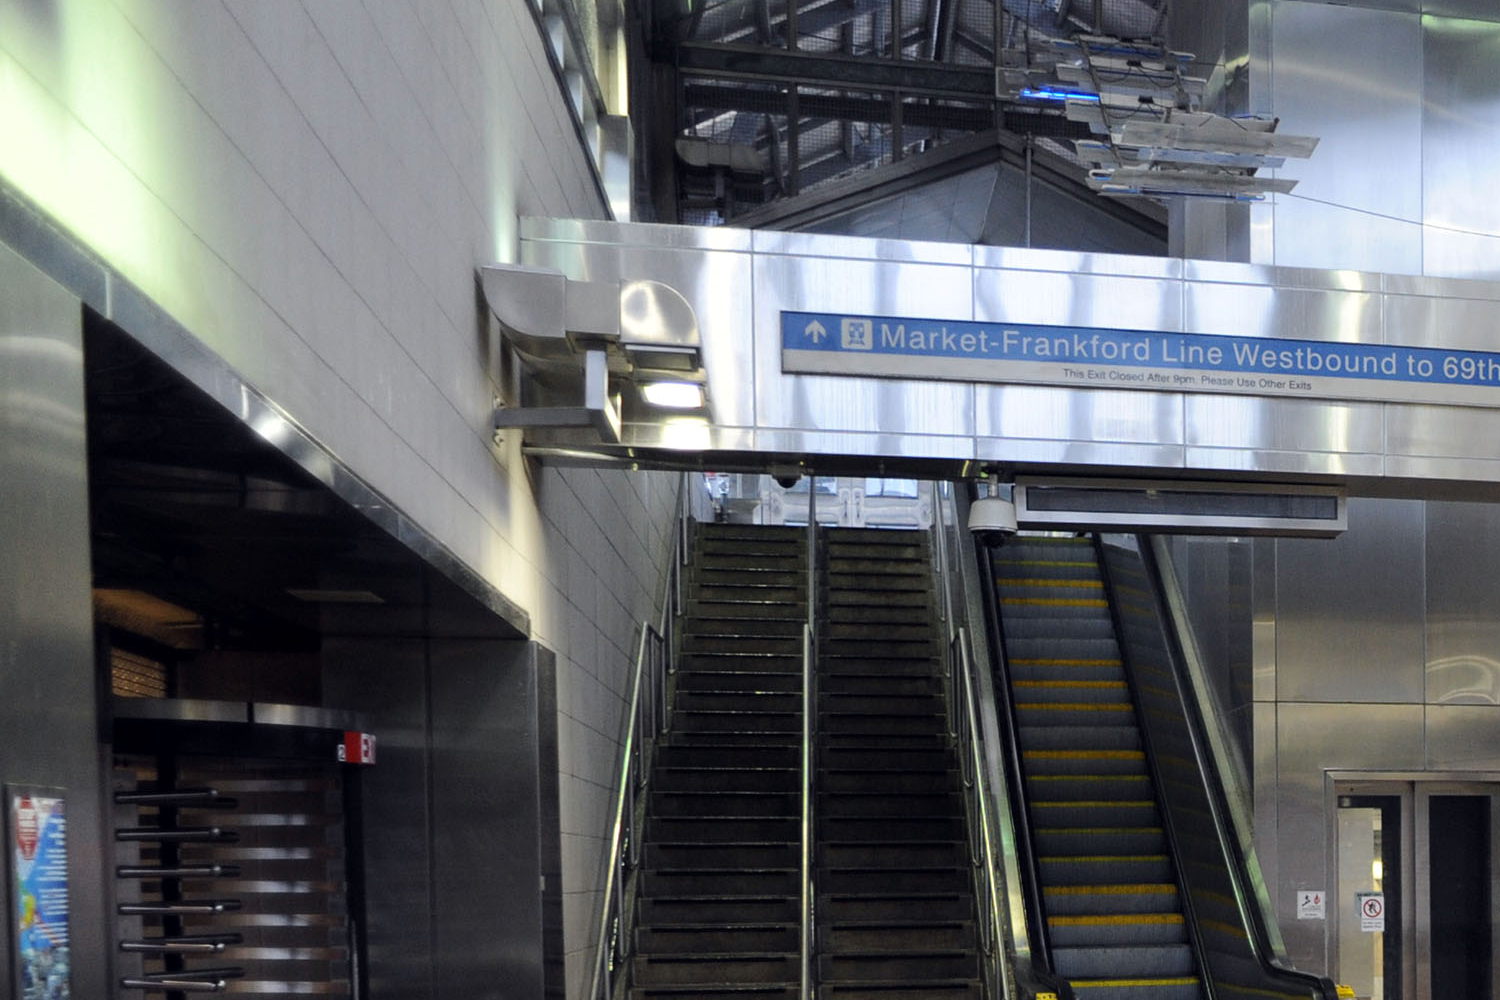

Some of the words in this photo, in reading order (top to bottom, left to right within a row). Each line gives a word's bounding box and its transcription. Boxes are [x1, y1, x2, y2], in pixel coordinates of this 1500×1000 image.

[881, 324, 1151, 361] Market-Frankford
[1162, 339, 1224, 364] Line
[1233, 342, 1398, 376] Westbound
[1407, 355, 1433, 377] to
[1063, 368, 1085, 379] This
[1087, 370, 1106, 380] Exit
[1109, 371, 1144, 382] Closed
[1147, 373, 1170, 384] After
[1201, 375, 1234, 386] Please
[1236, 377, 1256, 388] Use
[1259, 379, 1286, 389] Other
[1289, 380, 1312, 391] Exits
